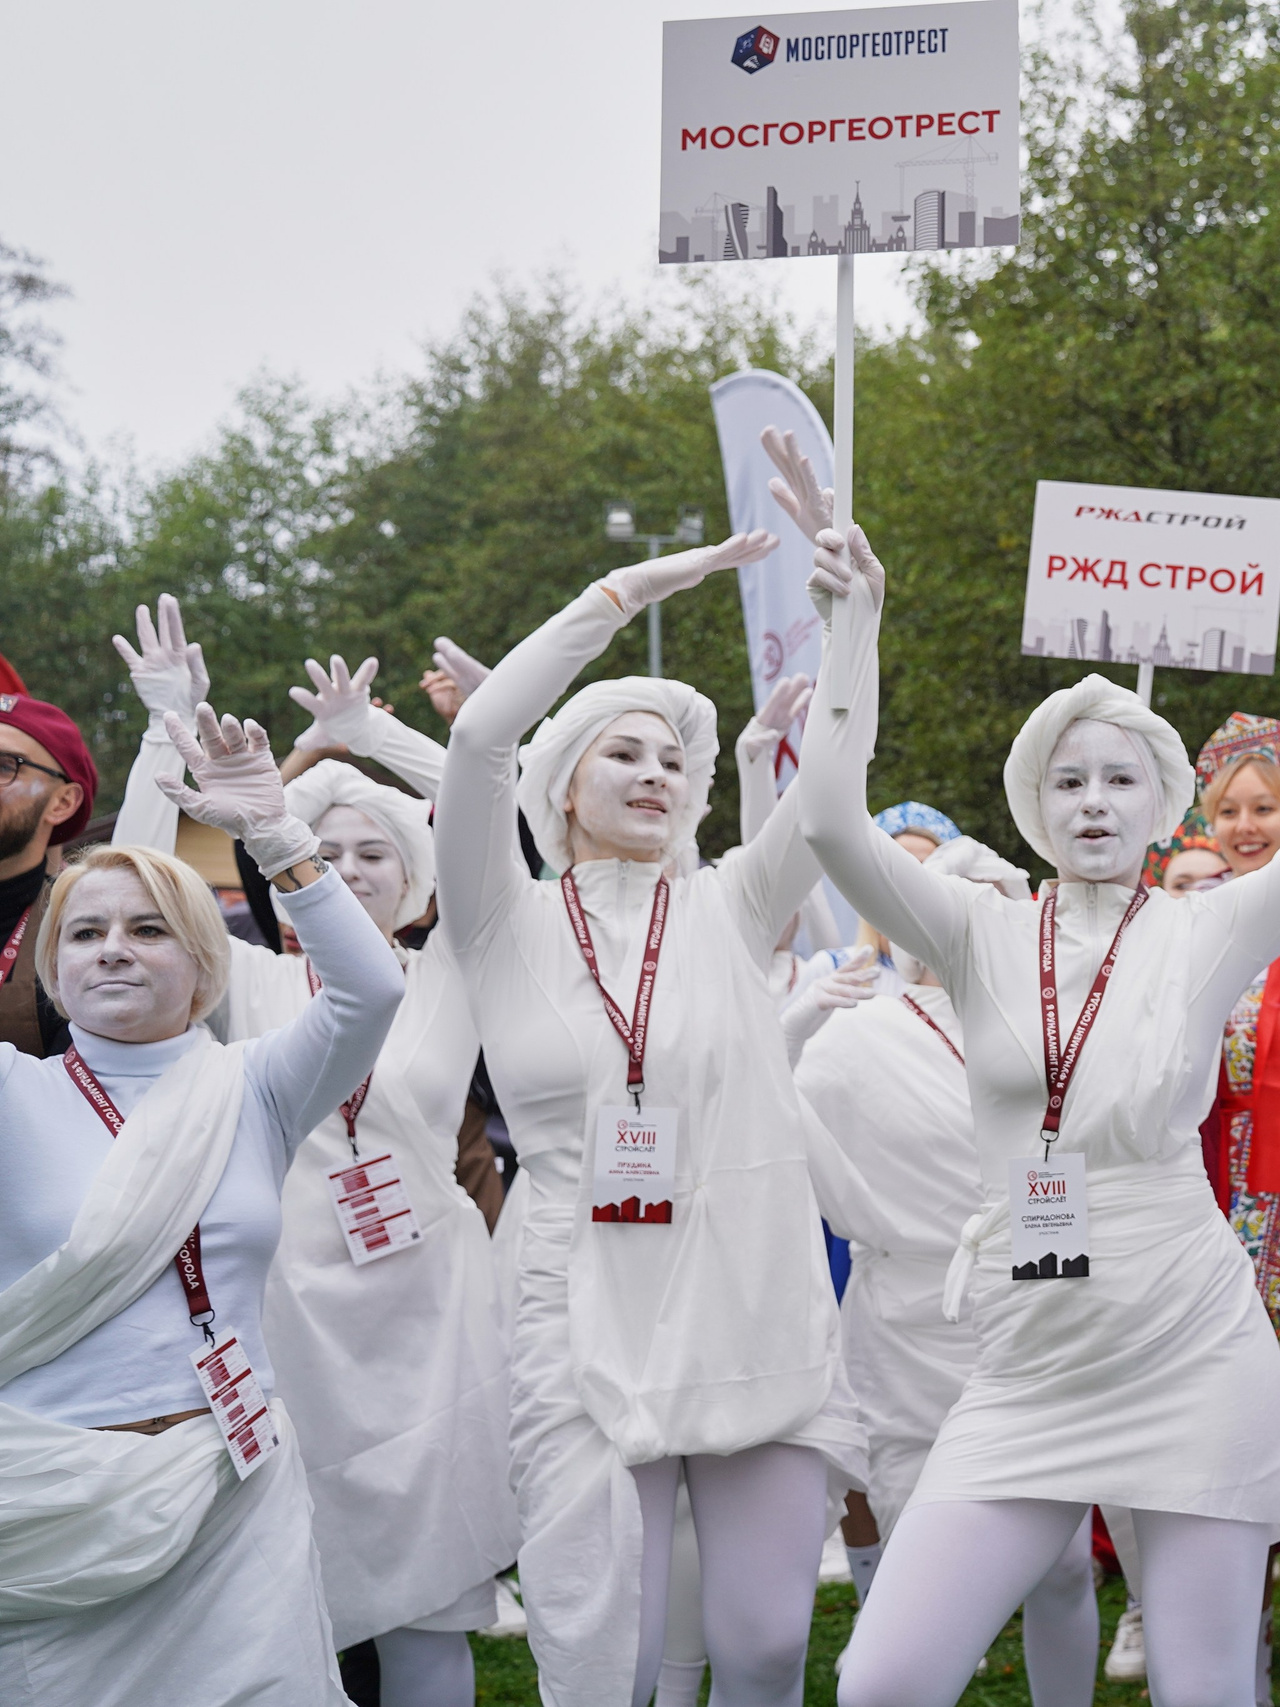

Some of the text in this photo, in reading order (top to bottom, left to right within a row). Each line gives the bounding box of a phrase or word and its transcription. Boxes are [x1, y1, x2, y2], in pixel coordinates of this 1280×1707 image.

[786, 28, 949, 63] МОСГОРГЕОТРЕСТ
[681, 110, 1001, 151] МОСГОРГЕОТРЕСТ
[1046, 554, 1265, 596] РЖД СТРОЙ
[1046, 1010, 1059, 1066] ФУНДАМЕНТ
[1059, 1025, 1087, 1081] ФУНДАМЕНТ
[1079, 991, 1102, 1027] ГОРОДА
[617, 1130, 656, 1145] XVIII
[1028, 1180, 1066, 1197] XVIII
[1021, 1213, 1076, 1222] СПИРИДОНОВА
